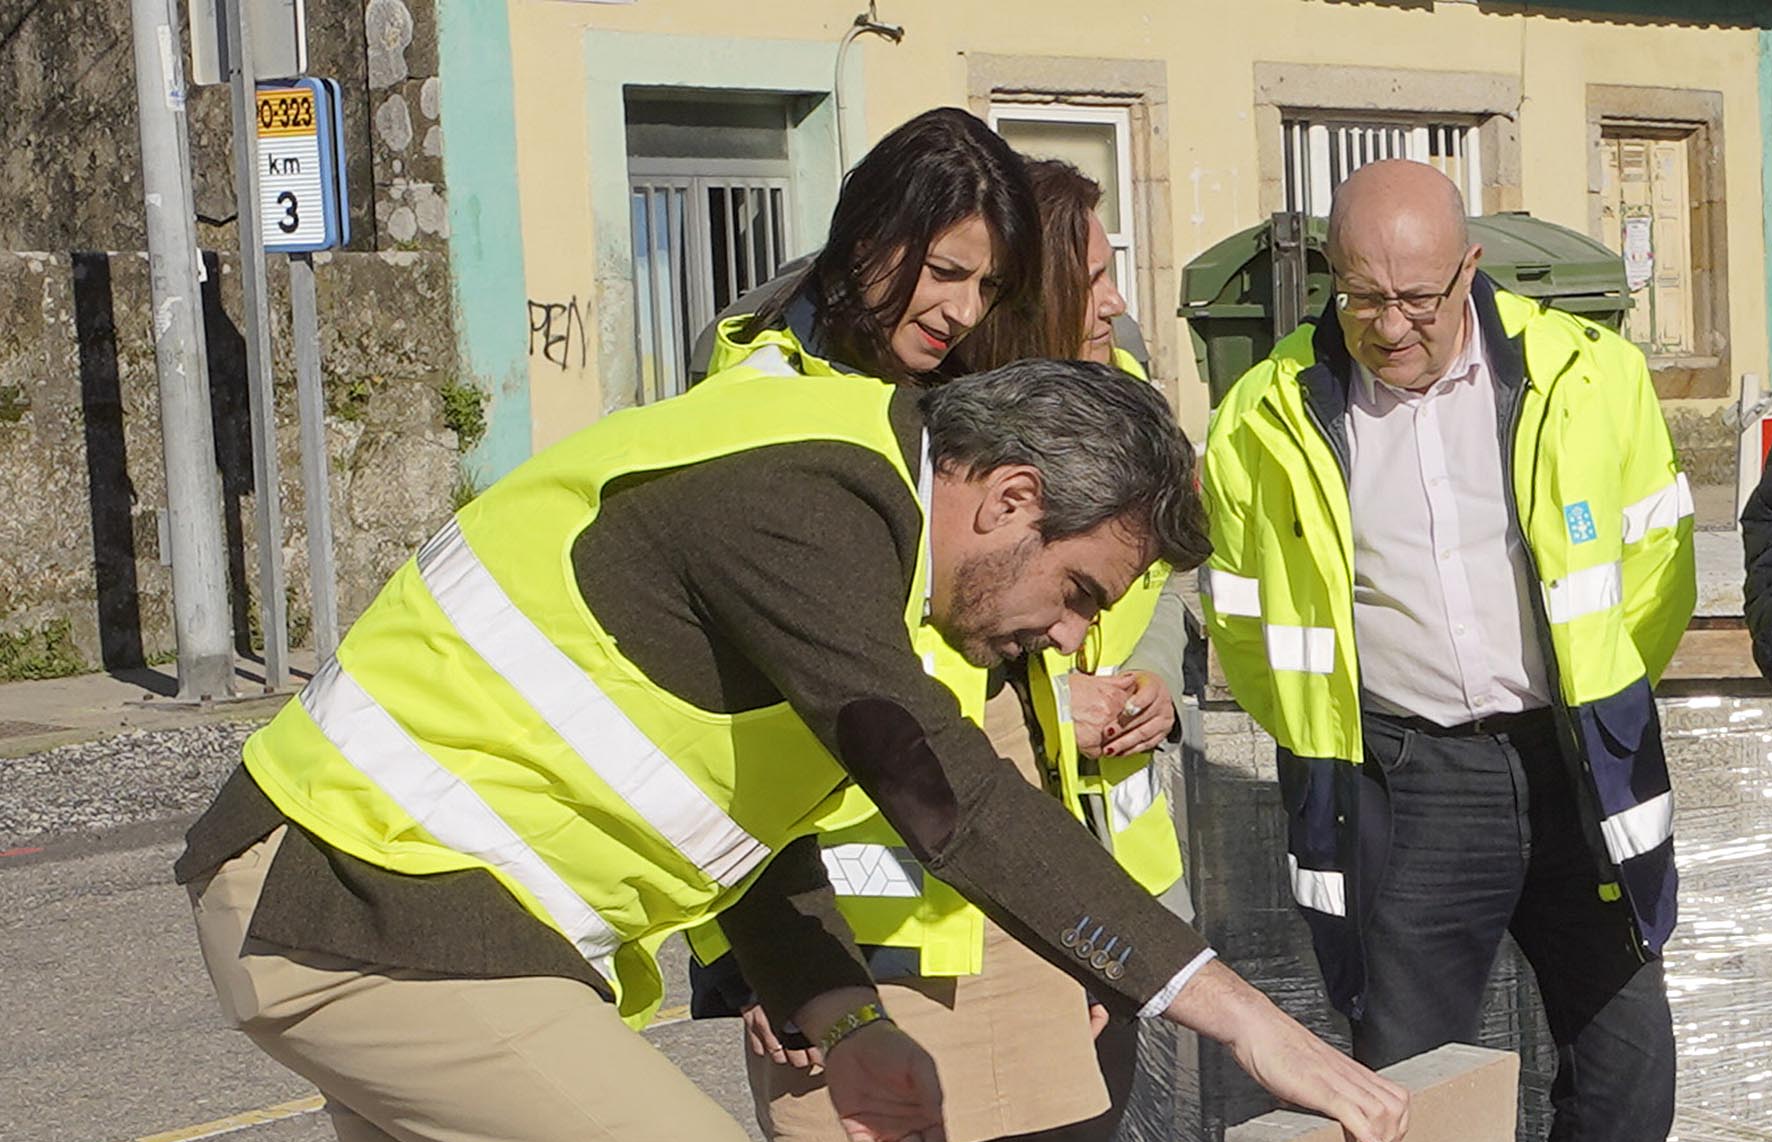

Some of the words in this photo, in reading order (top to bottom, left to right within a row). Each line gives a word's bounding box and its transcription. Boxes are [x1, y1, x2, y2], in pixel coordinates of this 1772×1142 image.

[256, 97, 312, 129] O-323
[268, 153, 301, 175] km
[276, 191, 299, 234] 3
